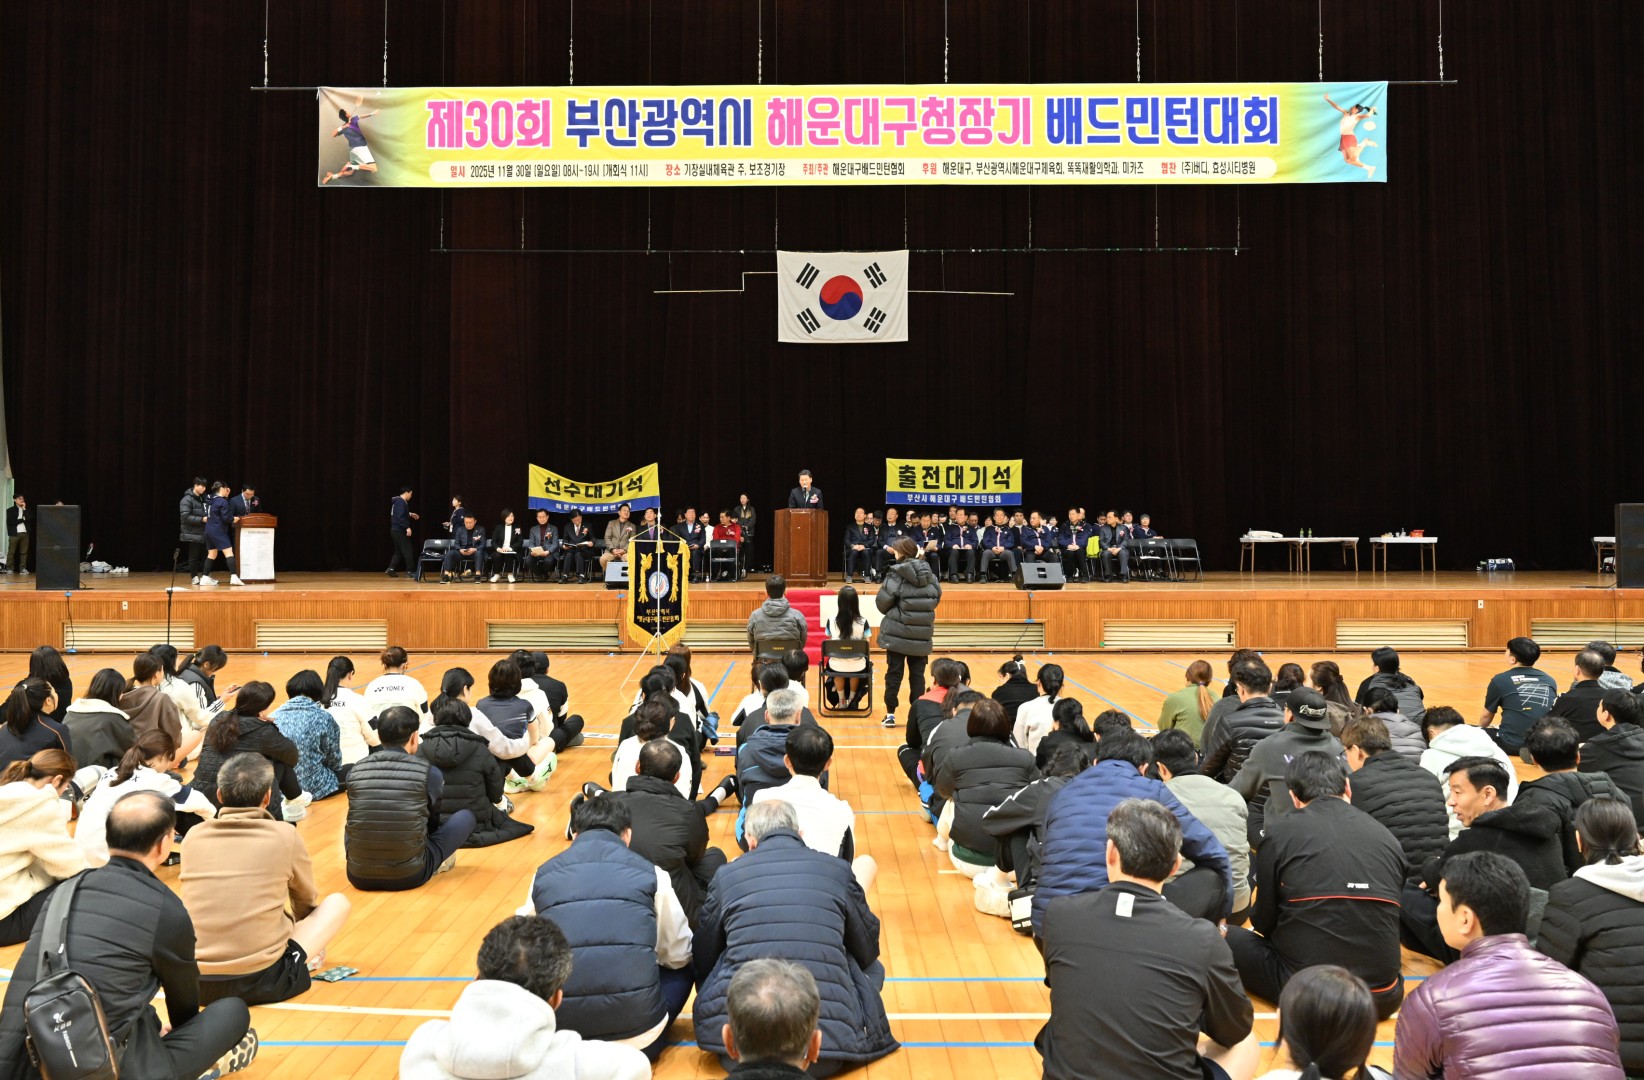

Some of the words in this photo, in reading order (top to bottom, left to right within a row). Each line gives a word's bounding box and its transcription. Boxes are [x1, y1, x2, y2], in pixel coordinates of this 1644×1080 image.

[427, 98, 550, 148] 제30회
[566, 98, 752, 148] 부산광역시
[767, 97, 1031, 146] 해운대구청장기
[1046, 96, 1278, 145] 배드민턴대회
[450, 165, 465, 178] 일시
[470, 164, 495, 178] 2025년
[497, 164, 513, 178] 11월
[515, 164, 532, 178] 30일
[562, 164, 600, 177] 08시~19시
[665, 164, 681, 176] 장소
[684, 163, 735, 176] 기장실내체육관
[749, 163, 786, 176] 보조경기장
[802, 163, 829, 176] 주최/주관
[832, 162, 905, 176] 해운대구배드민턴협회
[922, 162, 937, 175] 후원
[1122, 161, 1144, 175] 미카즈
[1161, 162, 1177, 175] 협찬
[1212, 161, 1256, 175] 효성시티병원
[544, 474, 643, 498] 선수대기석
[898, 464, 1011, 490] 출전대기석
[907, 493, 928, 503] 부산시
